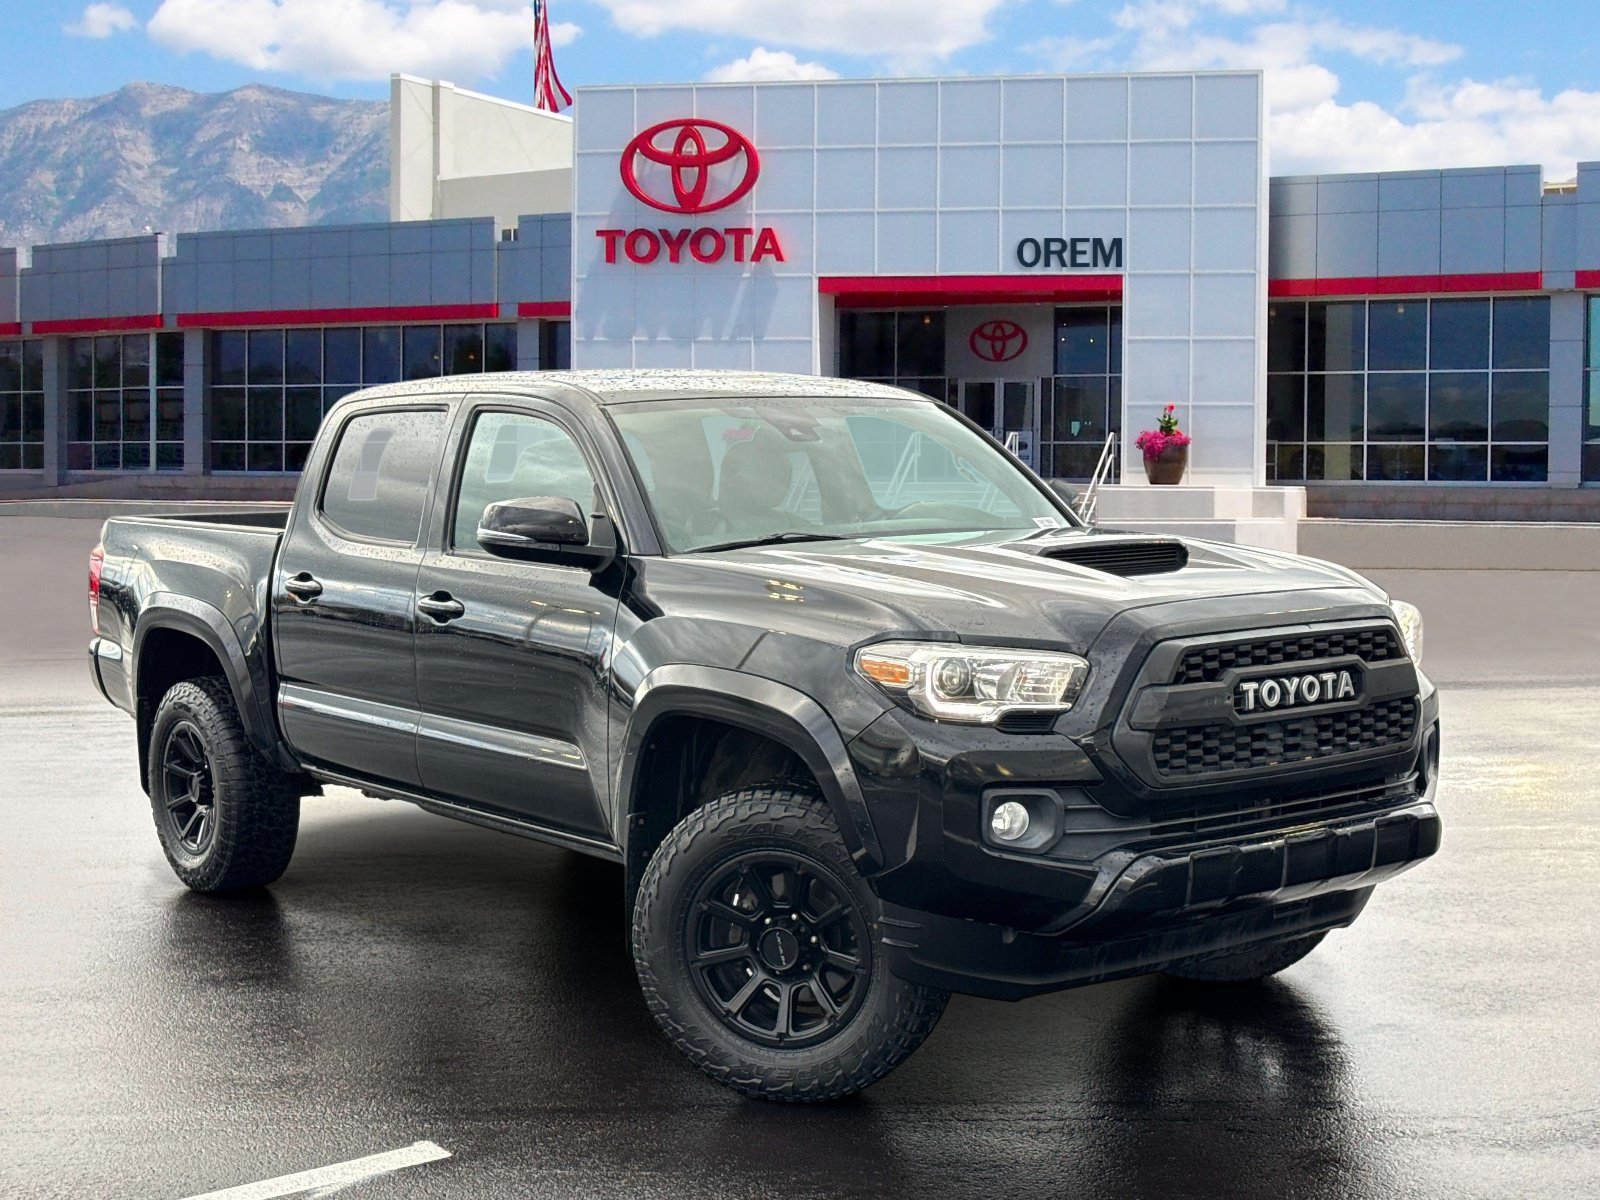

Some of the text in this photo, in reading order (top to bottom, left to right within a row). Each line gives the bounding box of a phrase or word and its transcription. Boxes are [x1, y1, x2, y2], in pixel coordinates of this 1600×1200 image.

[596, 227, 785, 264] TOYOTA
[1017, 238, 1122, 267] OREM
[1240, 671, 1355, 710] TOYOTA
